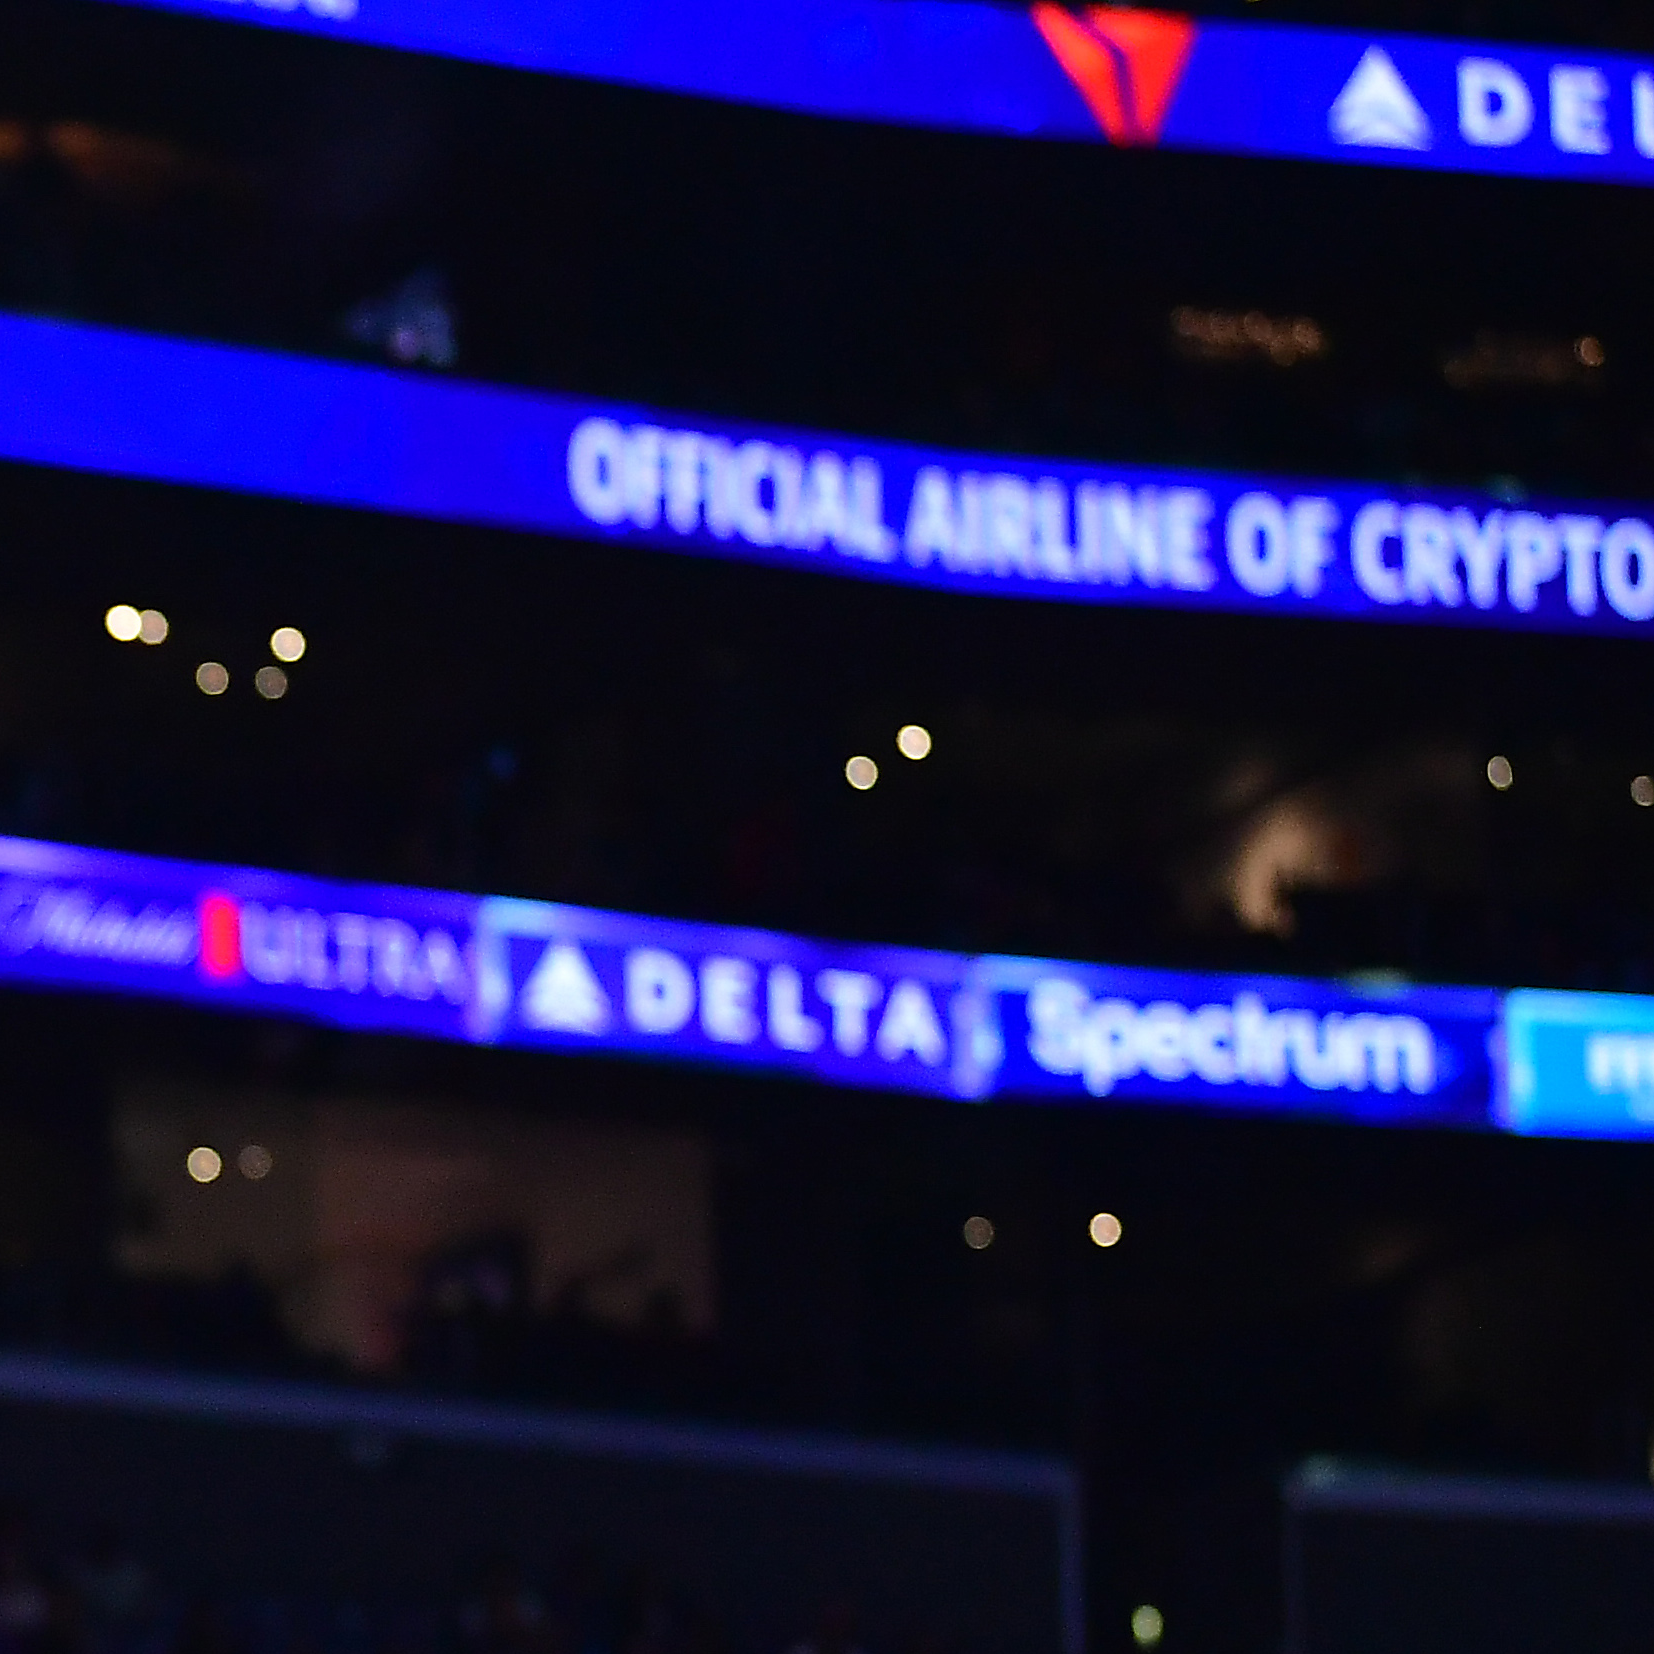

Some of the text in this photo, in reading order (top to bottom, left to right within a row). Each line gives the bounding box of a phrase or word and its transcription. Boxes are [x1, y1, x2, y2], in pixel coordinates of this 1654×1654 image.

[566, 415, 890, 562] OFFICIAL
[908, 465, 1218, 592] AIRLINE
[1224, 490, 1342, 599] OF
[241, 900, 473, 1007] ULTRA
[622, 947, 946, 1067] DELTA
[1027, 977, 1436, 1098] Spectrum
